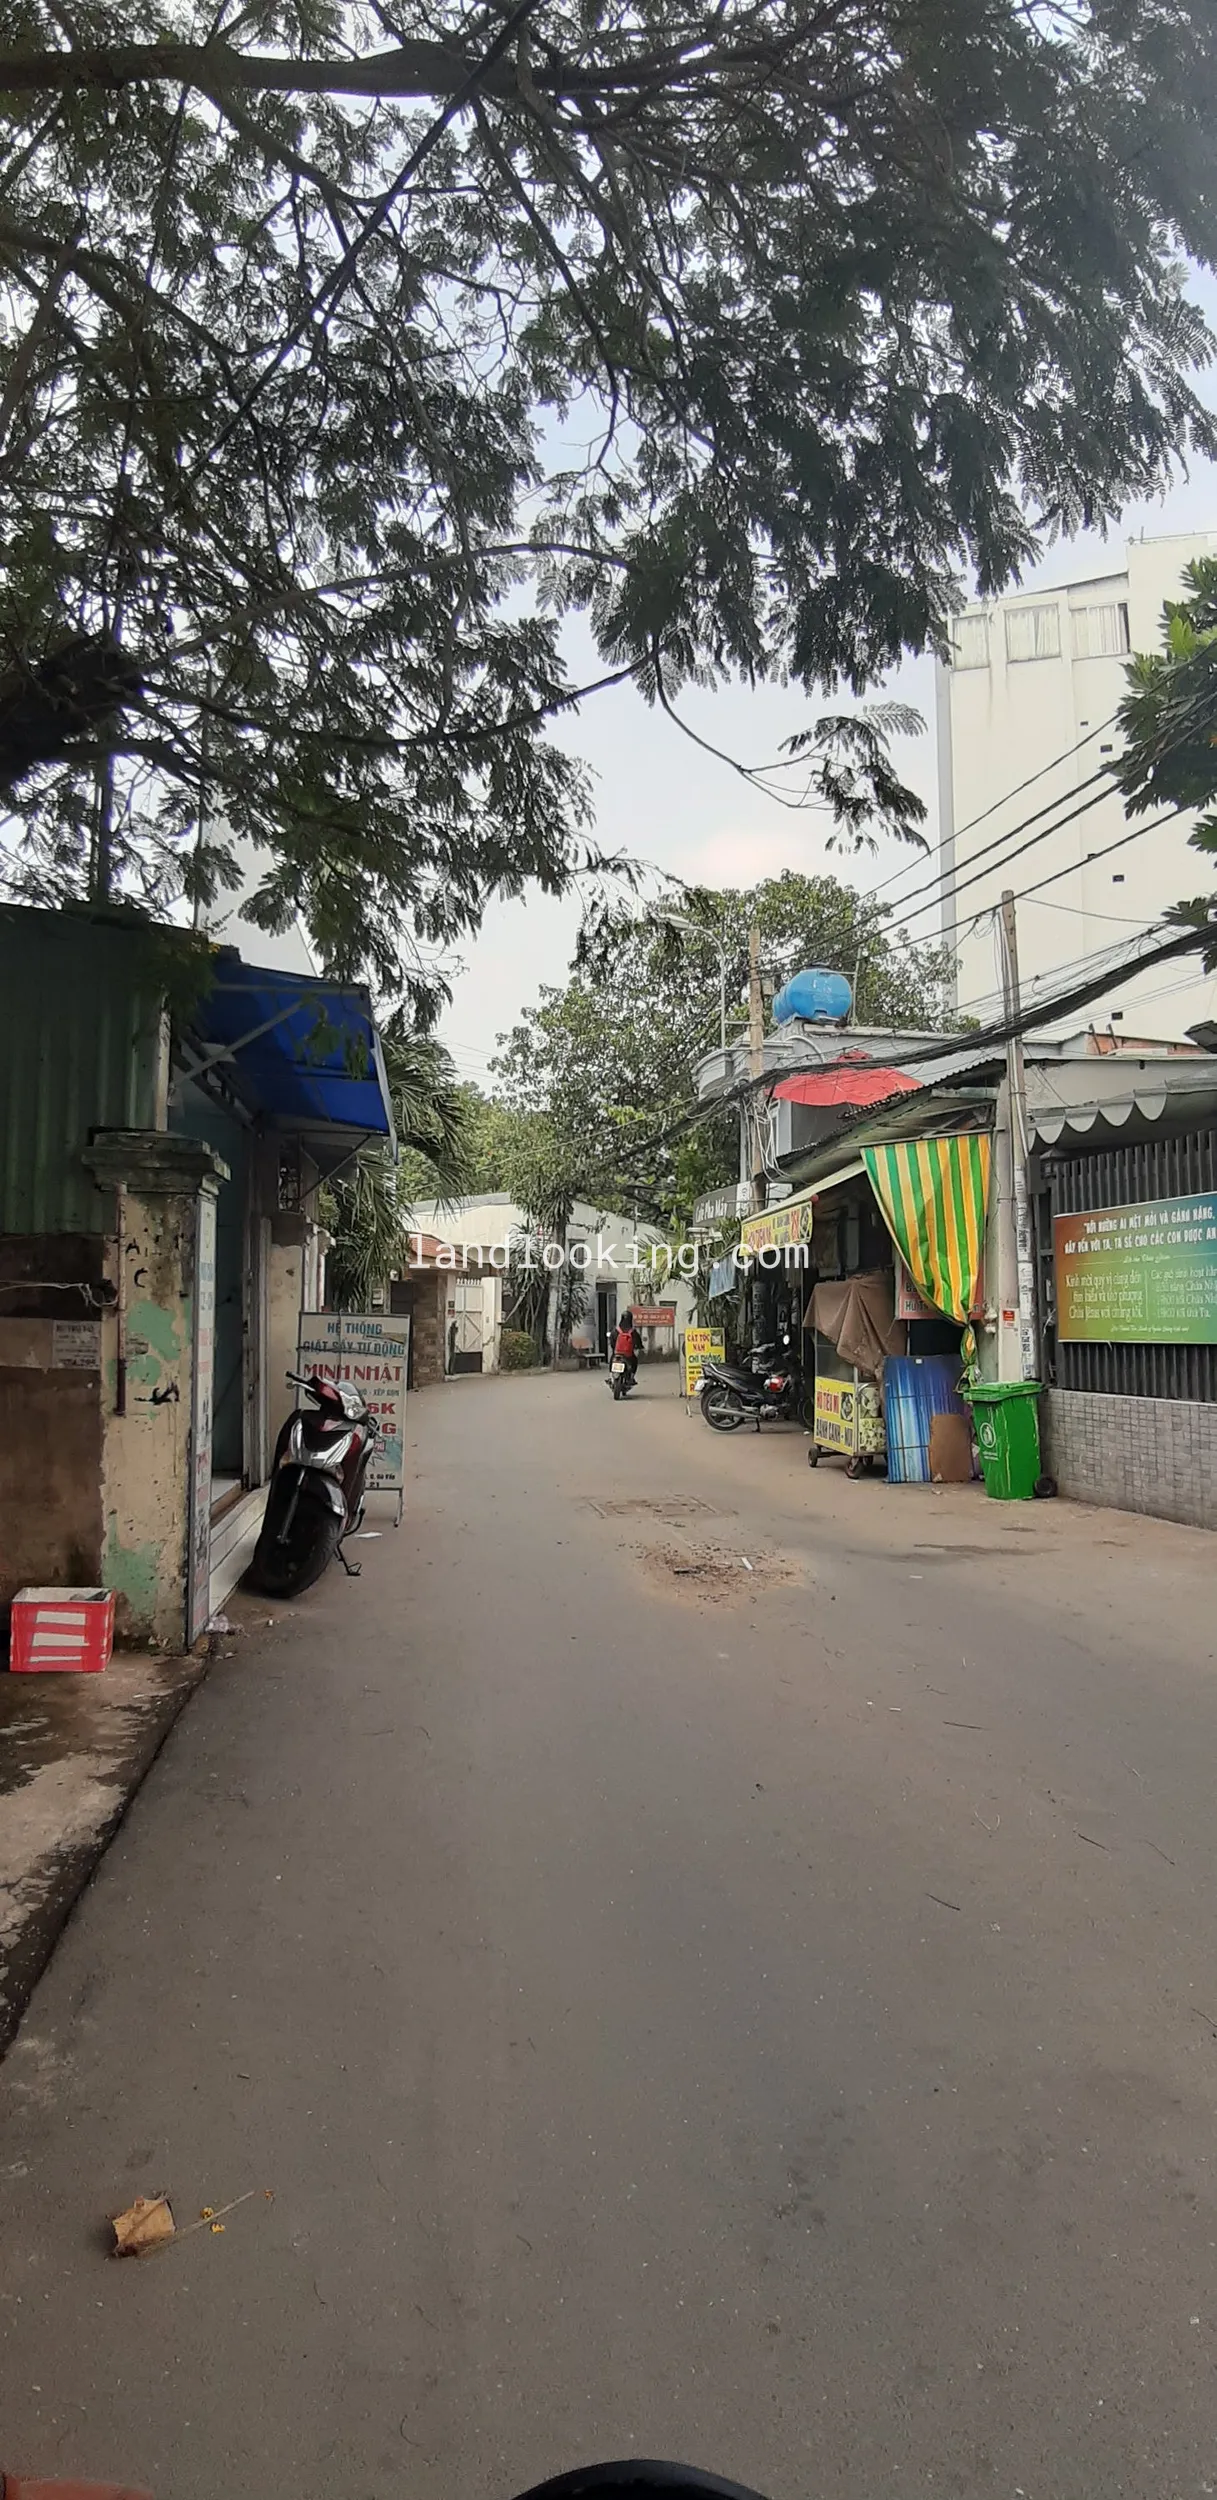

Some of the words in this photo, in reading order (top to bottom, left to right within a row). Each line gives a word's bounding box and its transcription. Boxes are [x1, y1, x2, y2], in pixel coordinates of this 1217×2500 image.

[1167, 1229, 1182, 1244] CON
[304, 1364, 350, 1381] MINH
[354, 1363, 403, 1384] NHẬT
